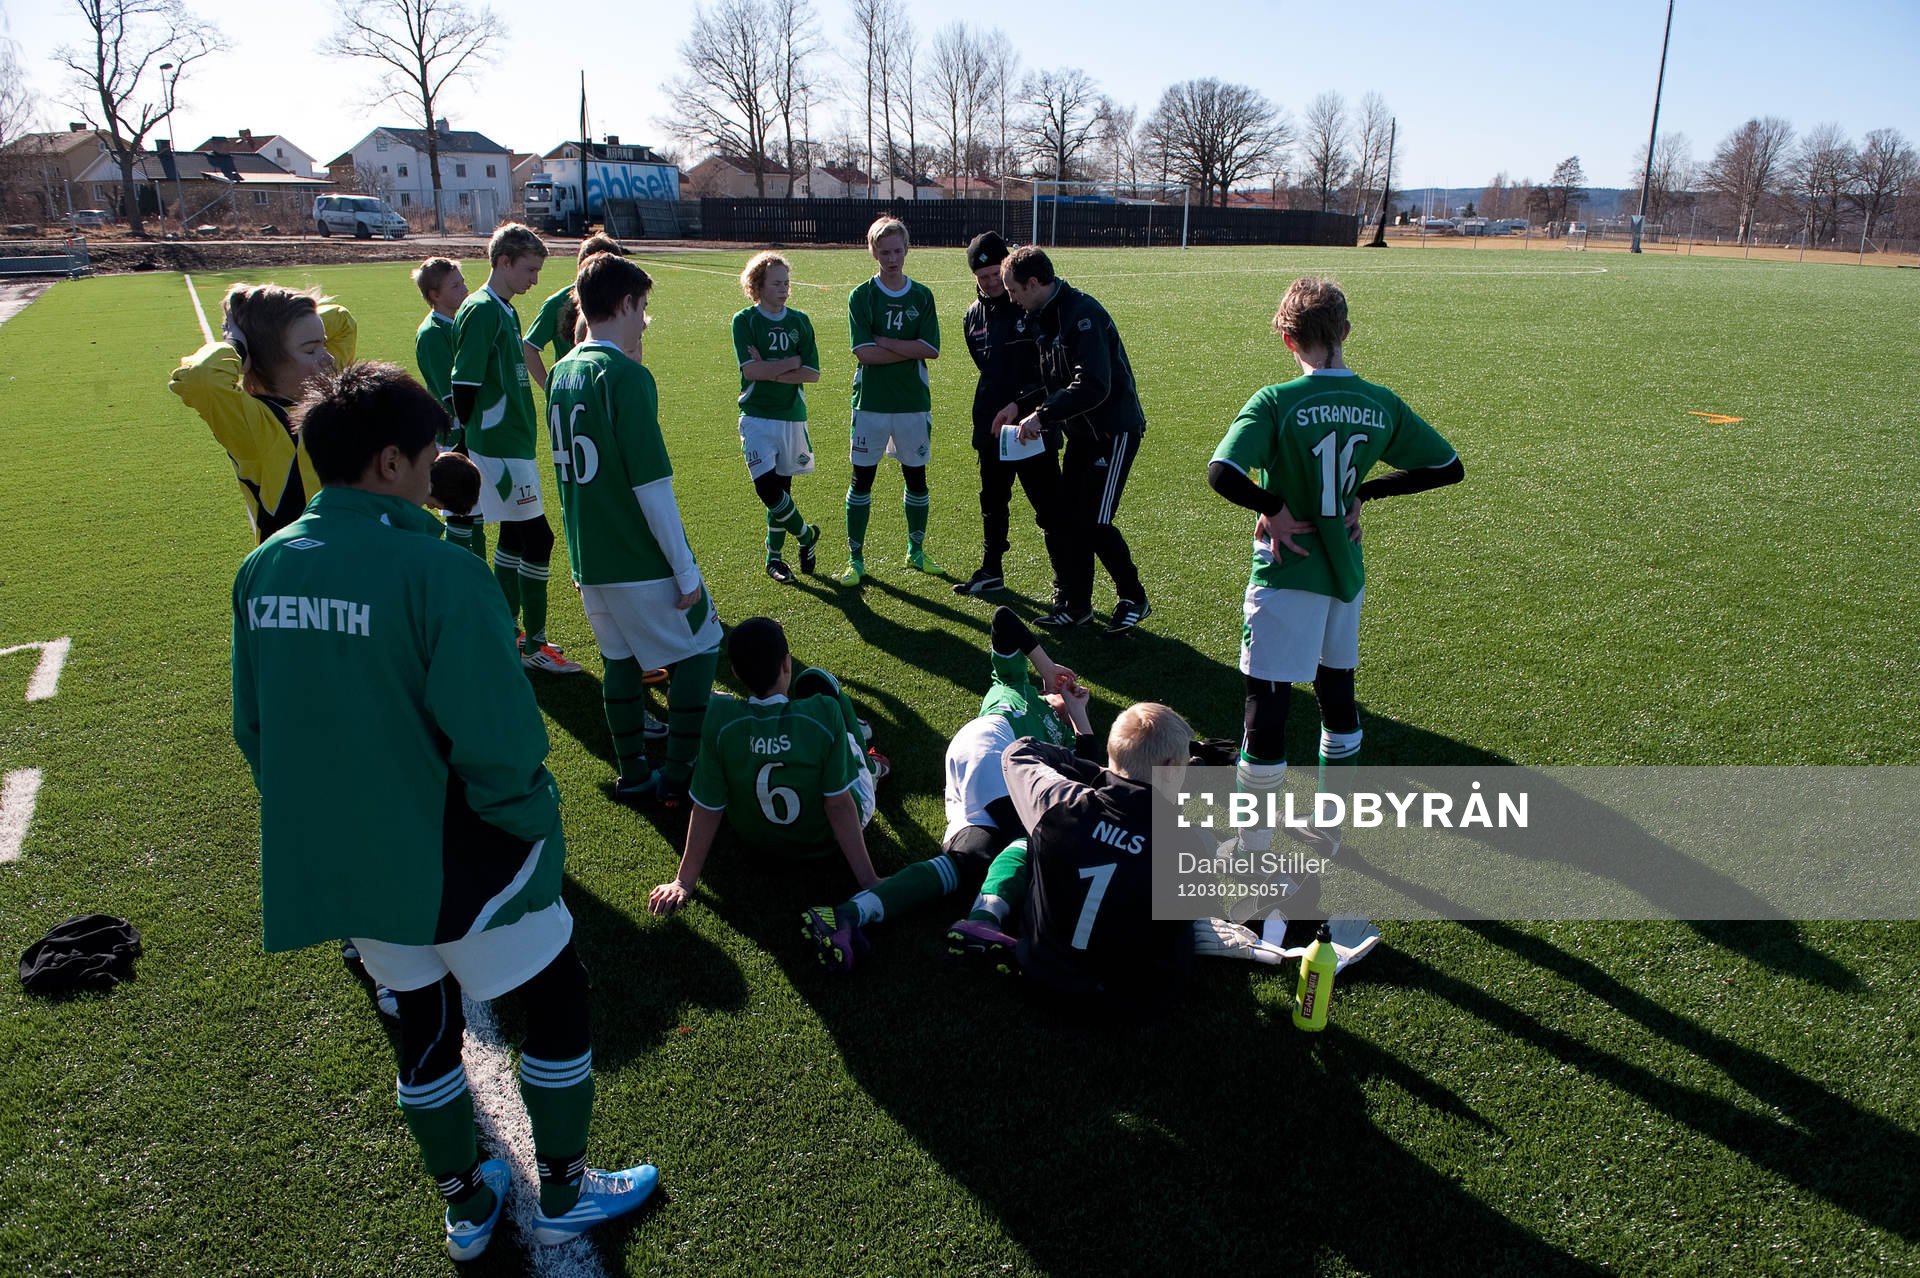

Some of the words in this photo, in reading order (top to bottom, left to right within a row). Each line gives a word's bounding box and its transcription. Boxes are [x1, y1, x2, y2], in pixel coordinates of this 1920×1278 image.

[885, 310, 903, 330] 14
[768, 331, 789, 351] 20
[1296, 404, 1386, 429] STRANDELL
[550, 403, 599, 484] 46
[1311, 430, 1368, 516] 16
[519, 484, 531, 498] 17
[756, 762, 801, 825] 6
[1092, 820, 1146, 855] NILS
[1071, 862, 1118, 950] 1
